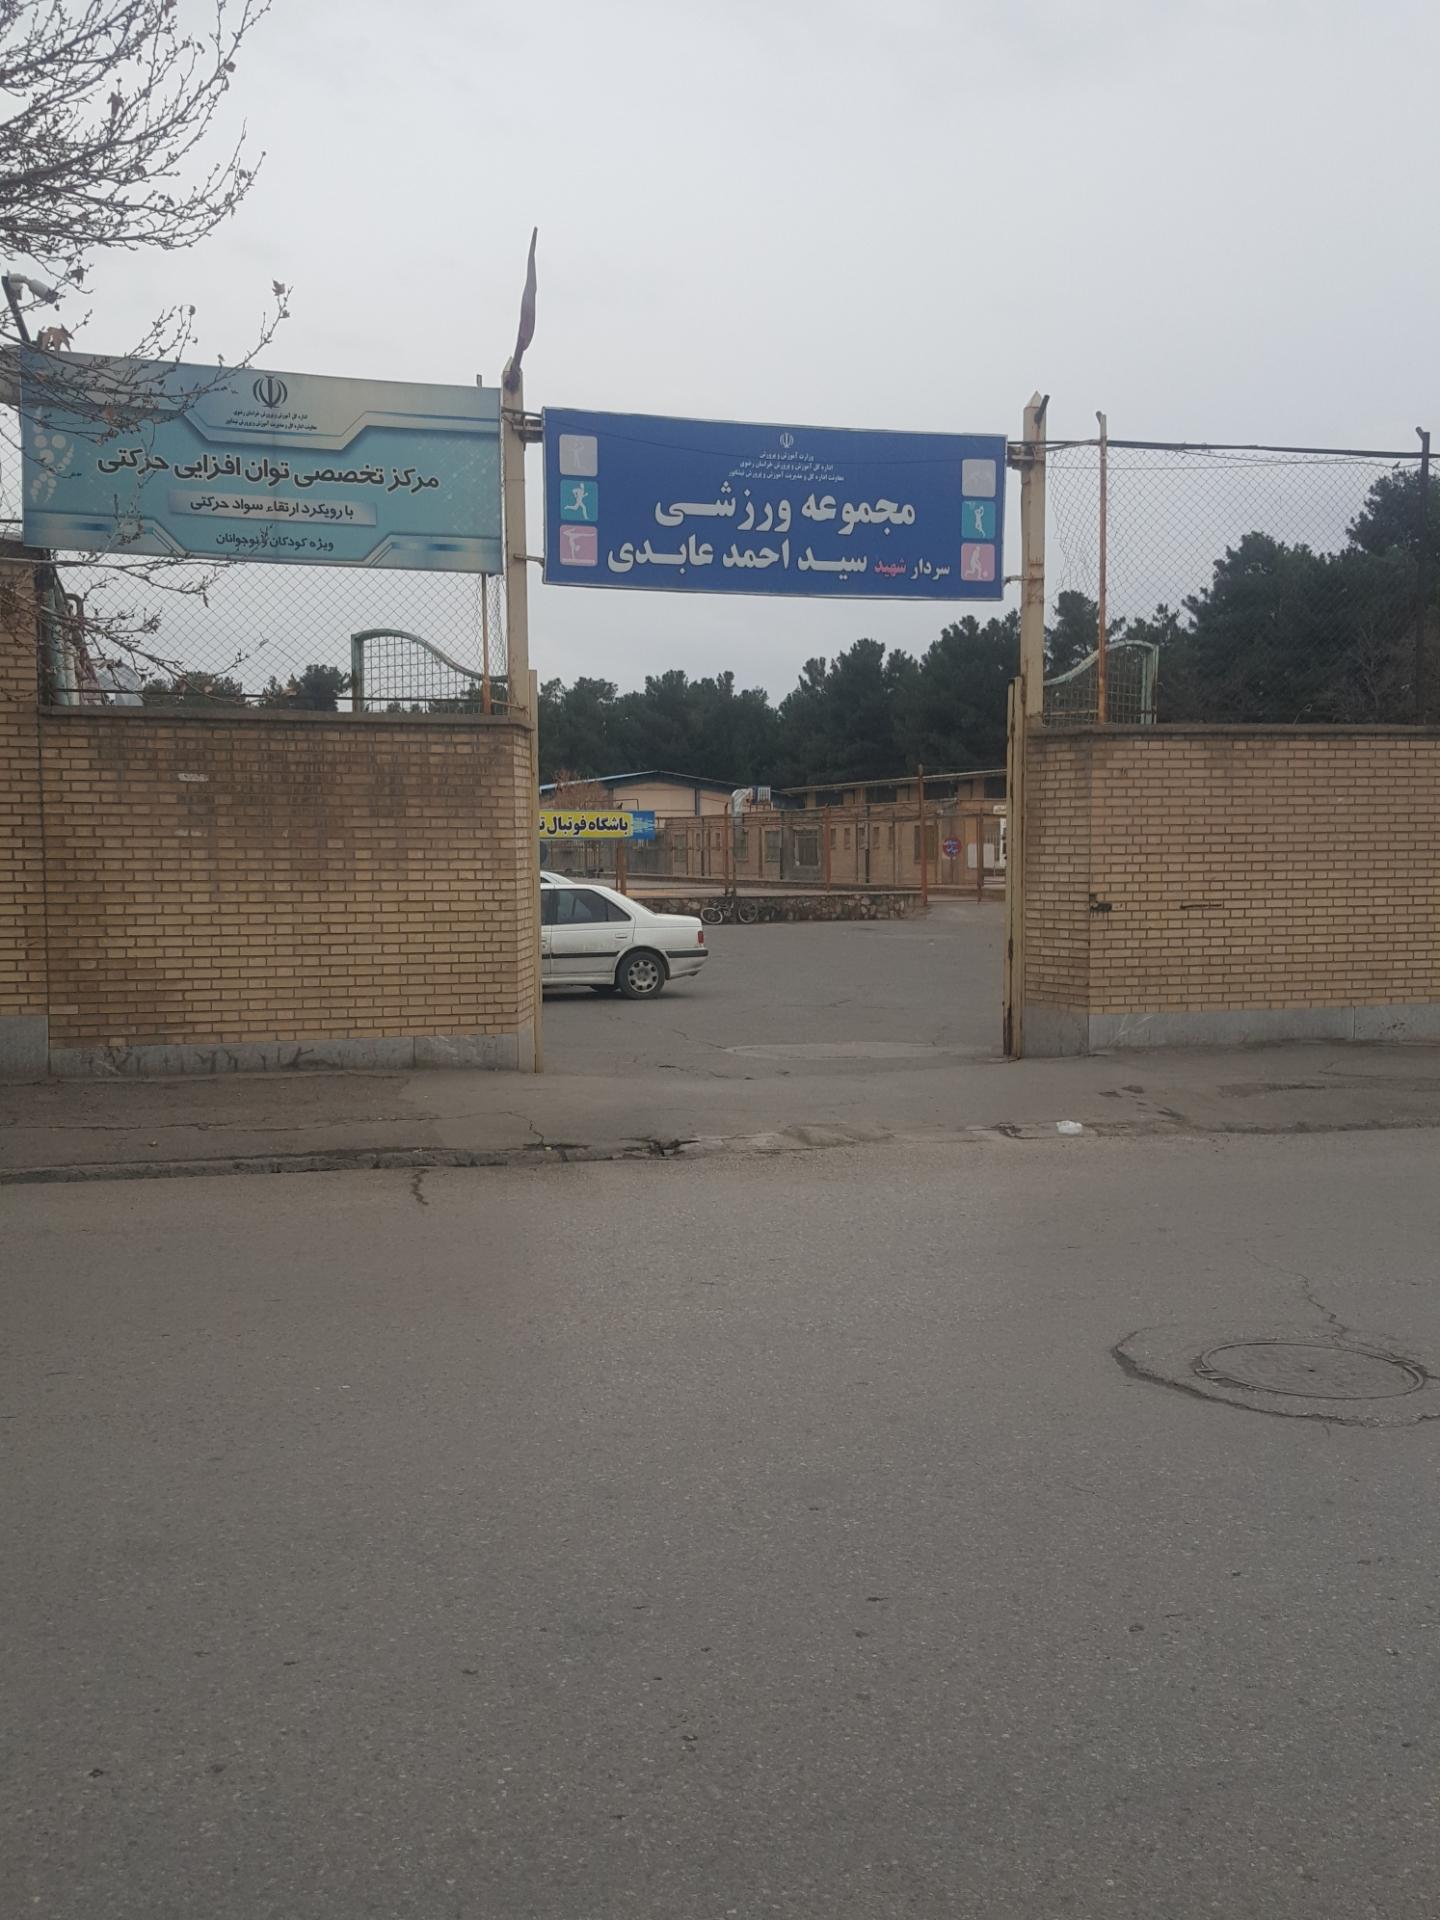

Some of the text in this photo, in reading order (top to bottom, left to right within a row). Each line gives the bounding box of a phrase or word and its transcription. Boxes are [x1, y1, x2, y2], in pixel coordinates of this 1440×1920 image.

[759, 450, 777, 460] پرورش
[781, 451, 798, 460] آموزش
[799, 452, 815, 462] وزارت
[739, 460, 755, 468] رضوی
[755, 460, 773, 469] خراسان
[774, 463, 791, 471] پرورش
[795, 462, 812, 471] آموزش
[821, 464, 834, 473] اداره
[98, 449, 440, 493] مرکز تخصصی توان افزایی حرکتی
[745, 470, 763, 478] پرورش
[767, 471, 784, 480] آموزش
[784, 472, 803, 480] مدیریت
[815, 473, 828, 482] اداره
[828, 474, 845, 483] معاونت
[190, 497, 354, 519] با رویکرد ارتقاء سواد حرکتی
[654, 480, 916, 535] مجموعه ورزشی
[216, 533, 260, 548] نوجوانان
[269, 536, 307, 550] کودکان
[308, 538, 334, 551] ویژه
[607, 533, 950, 580] سردار شهید سید احمد عابدی
[546, 815, 587, 835] فوتبال
[588, 817, 628, 835] باشگاه
